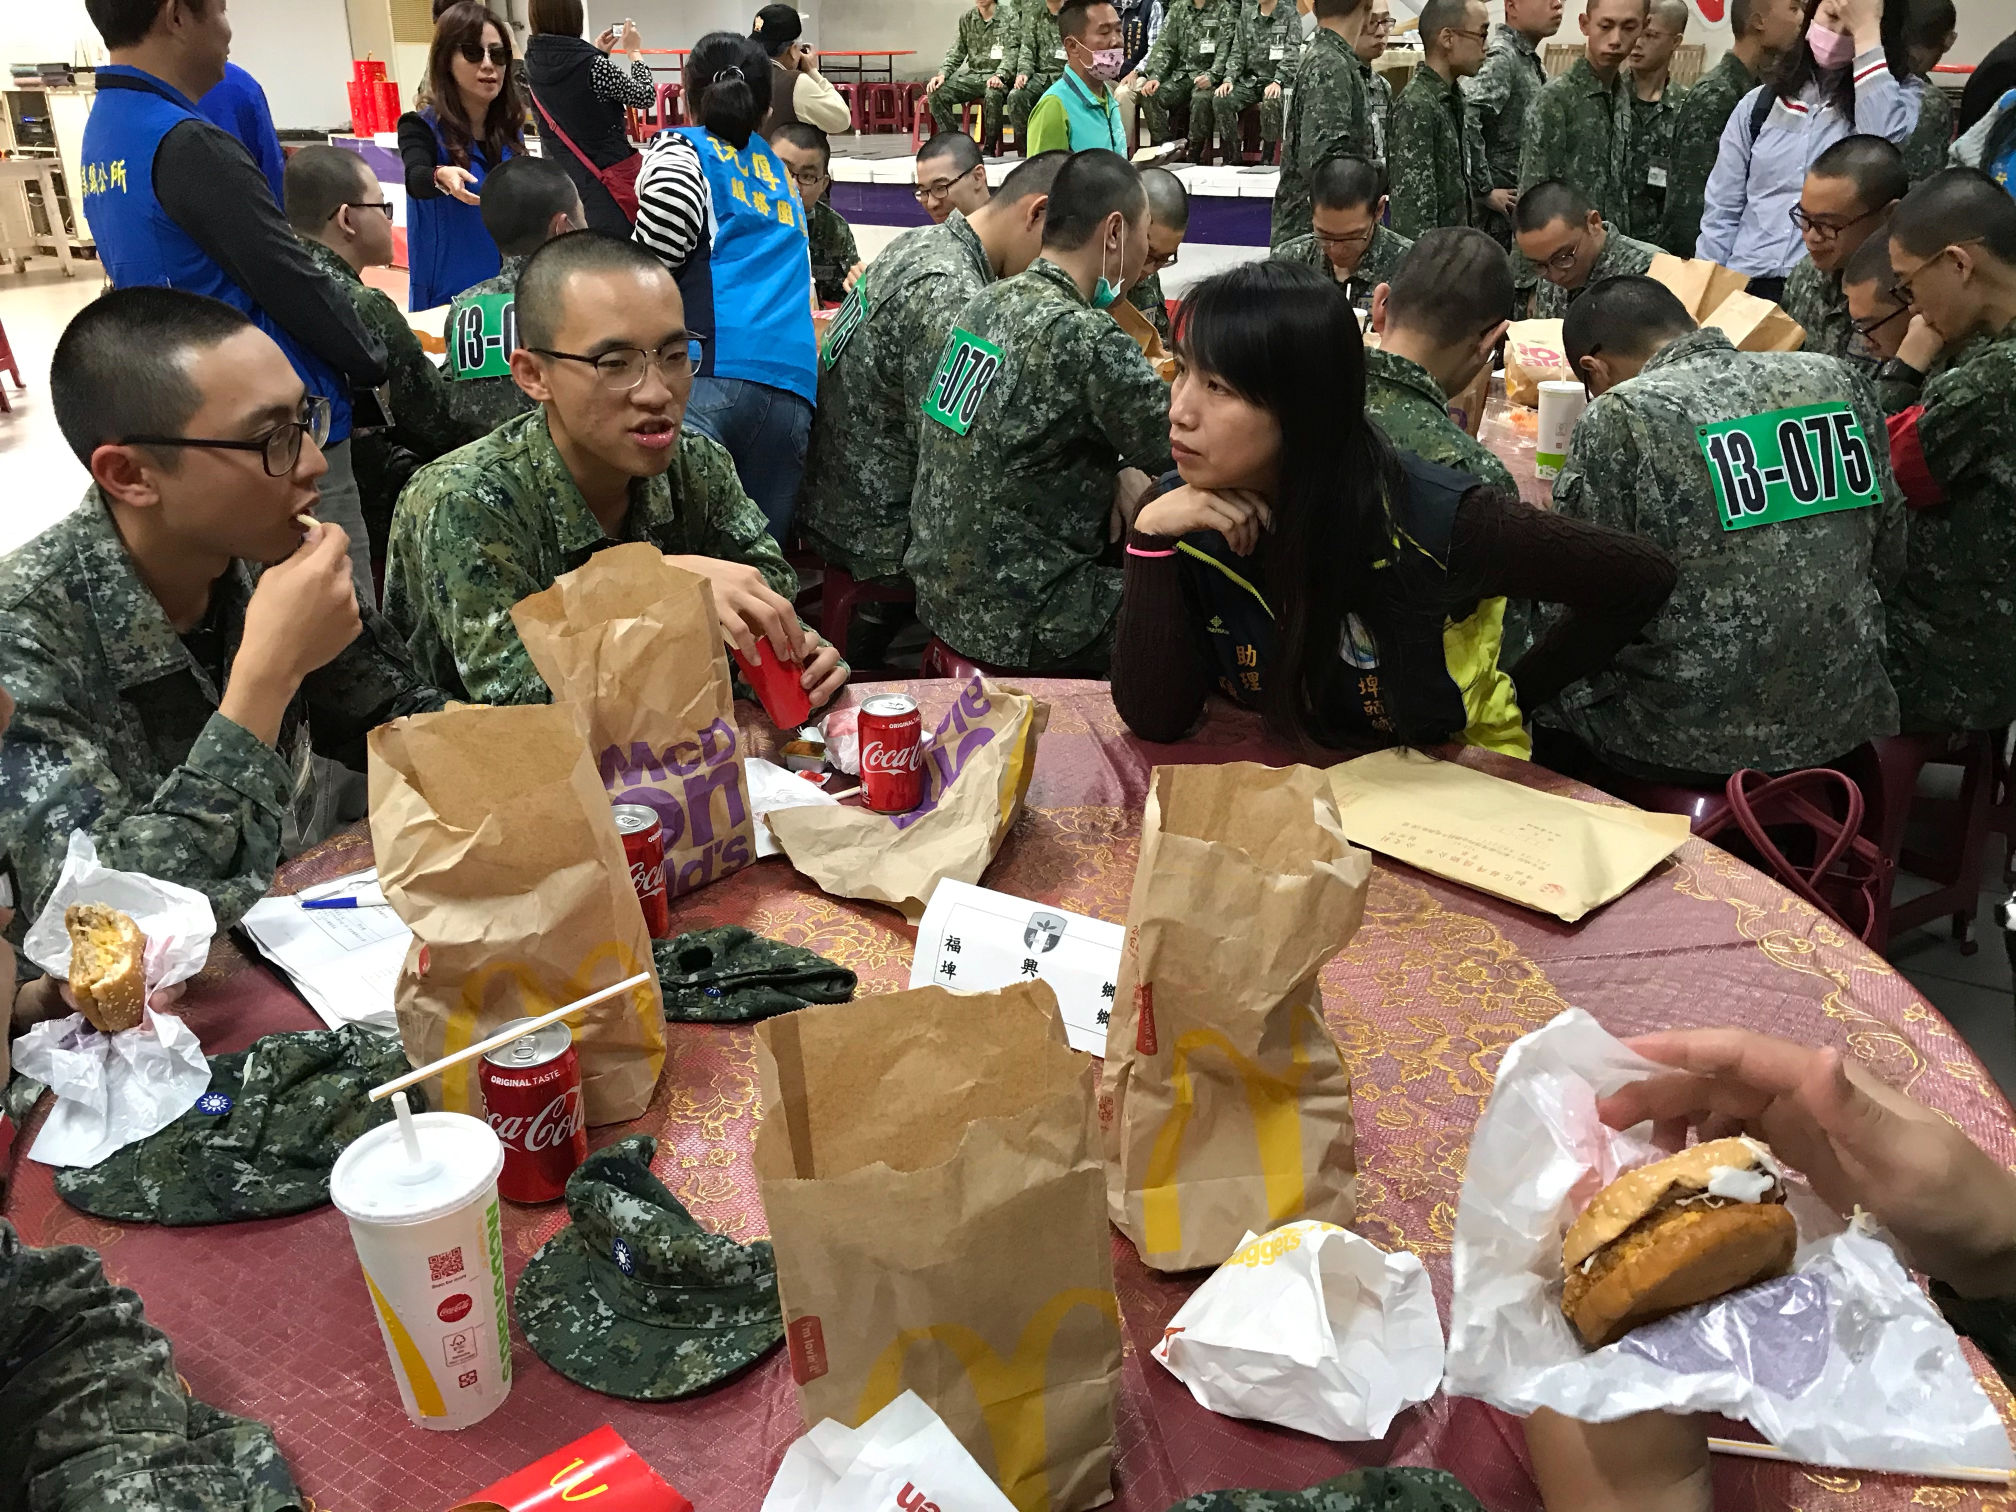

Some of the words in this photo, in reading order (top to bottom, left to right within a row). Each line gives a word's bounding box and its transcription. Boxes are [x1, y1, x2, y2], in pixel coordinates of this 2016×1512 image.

[1706, 411, 1874, 519] 13-075
[1236, 644, 1263, 692] 助理
[600, 717, 737, 791] McD
[664, 835, 750, 900] ld's
[939, 960, 957, 981] 埤
[944, 935, 962, 954] 福
[1021, 958, 1039, 978] 興
[1101, 981, 1117, 1002] 鄉
[490, 1075, 532, 1087] ORIGINAL
[532, 1069, 561, 1085] TASTE
[1222, 1231, 1302, 1268] uggets
